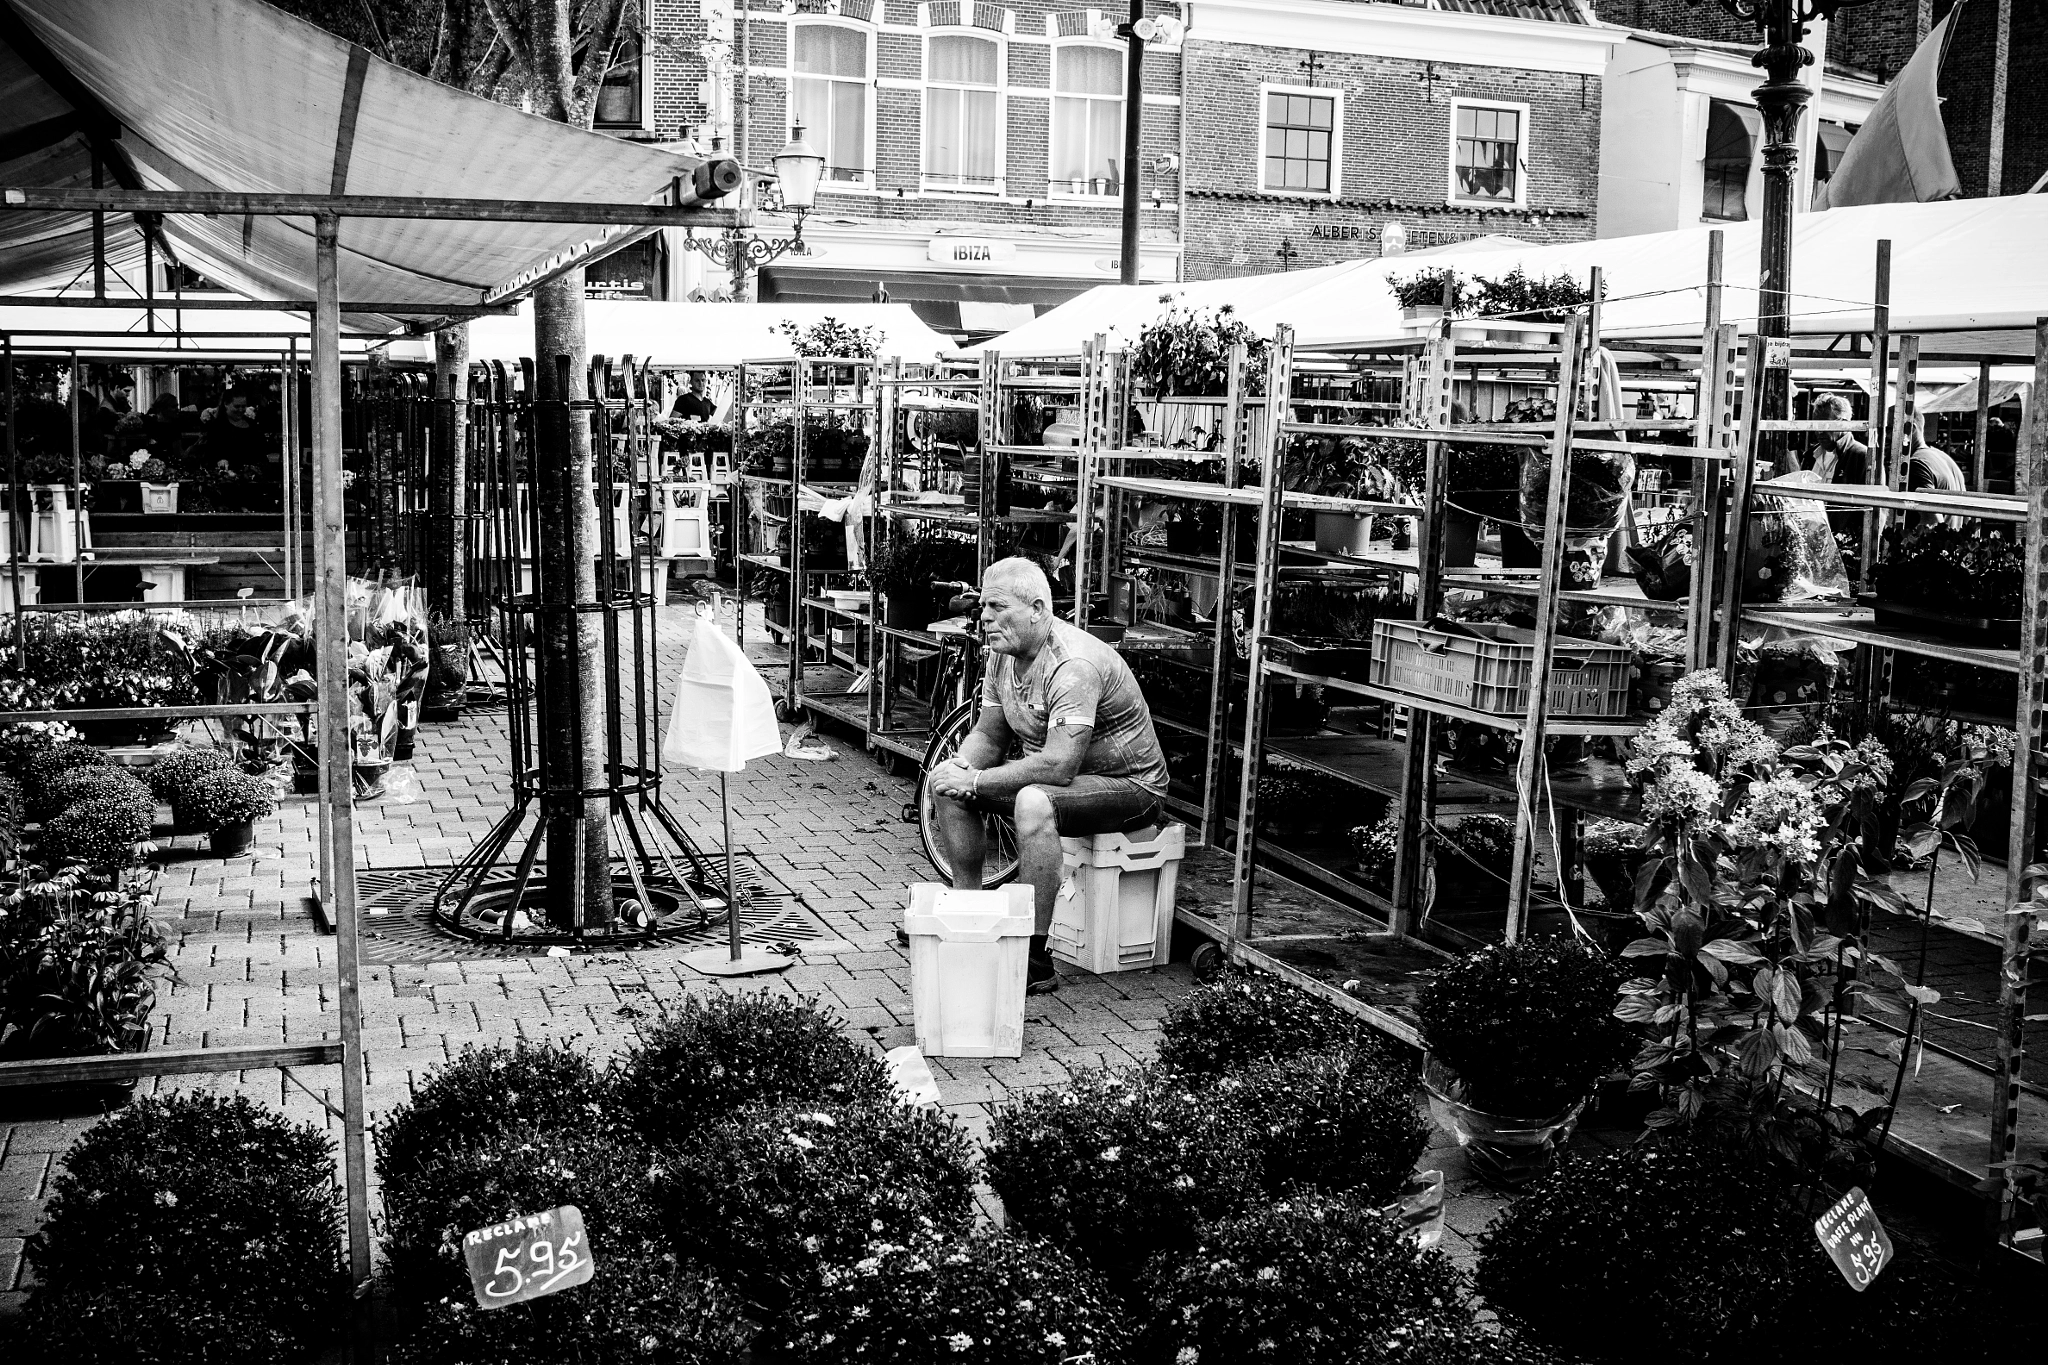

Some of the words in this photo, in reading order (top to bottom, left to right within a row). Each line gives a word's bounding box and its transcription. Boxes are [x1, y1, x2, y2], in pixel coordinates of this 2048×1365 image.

[953, 245, 991, 261] IBIZA
[1410, 230, 1447, 244] ETEN
[467, 1213, 551, 1246] RECLAME
[485, 1231, 582, 1297] 5.95
[1850, 1230, 1882, 1284] 5.95
